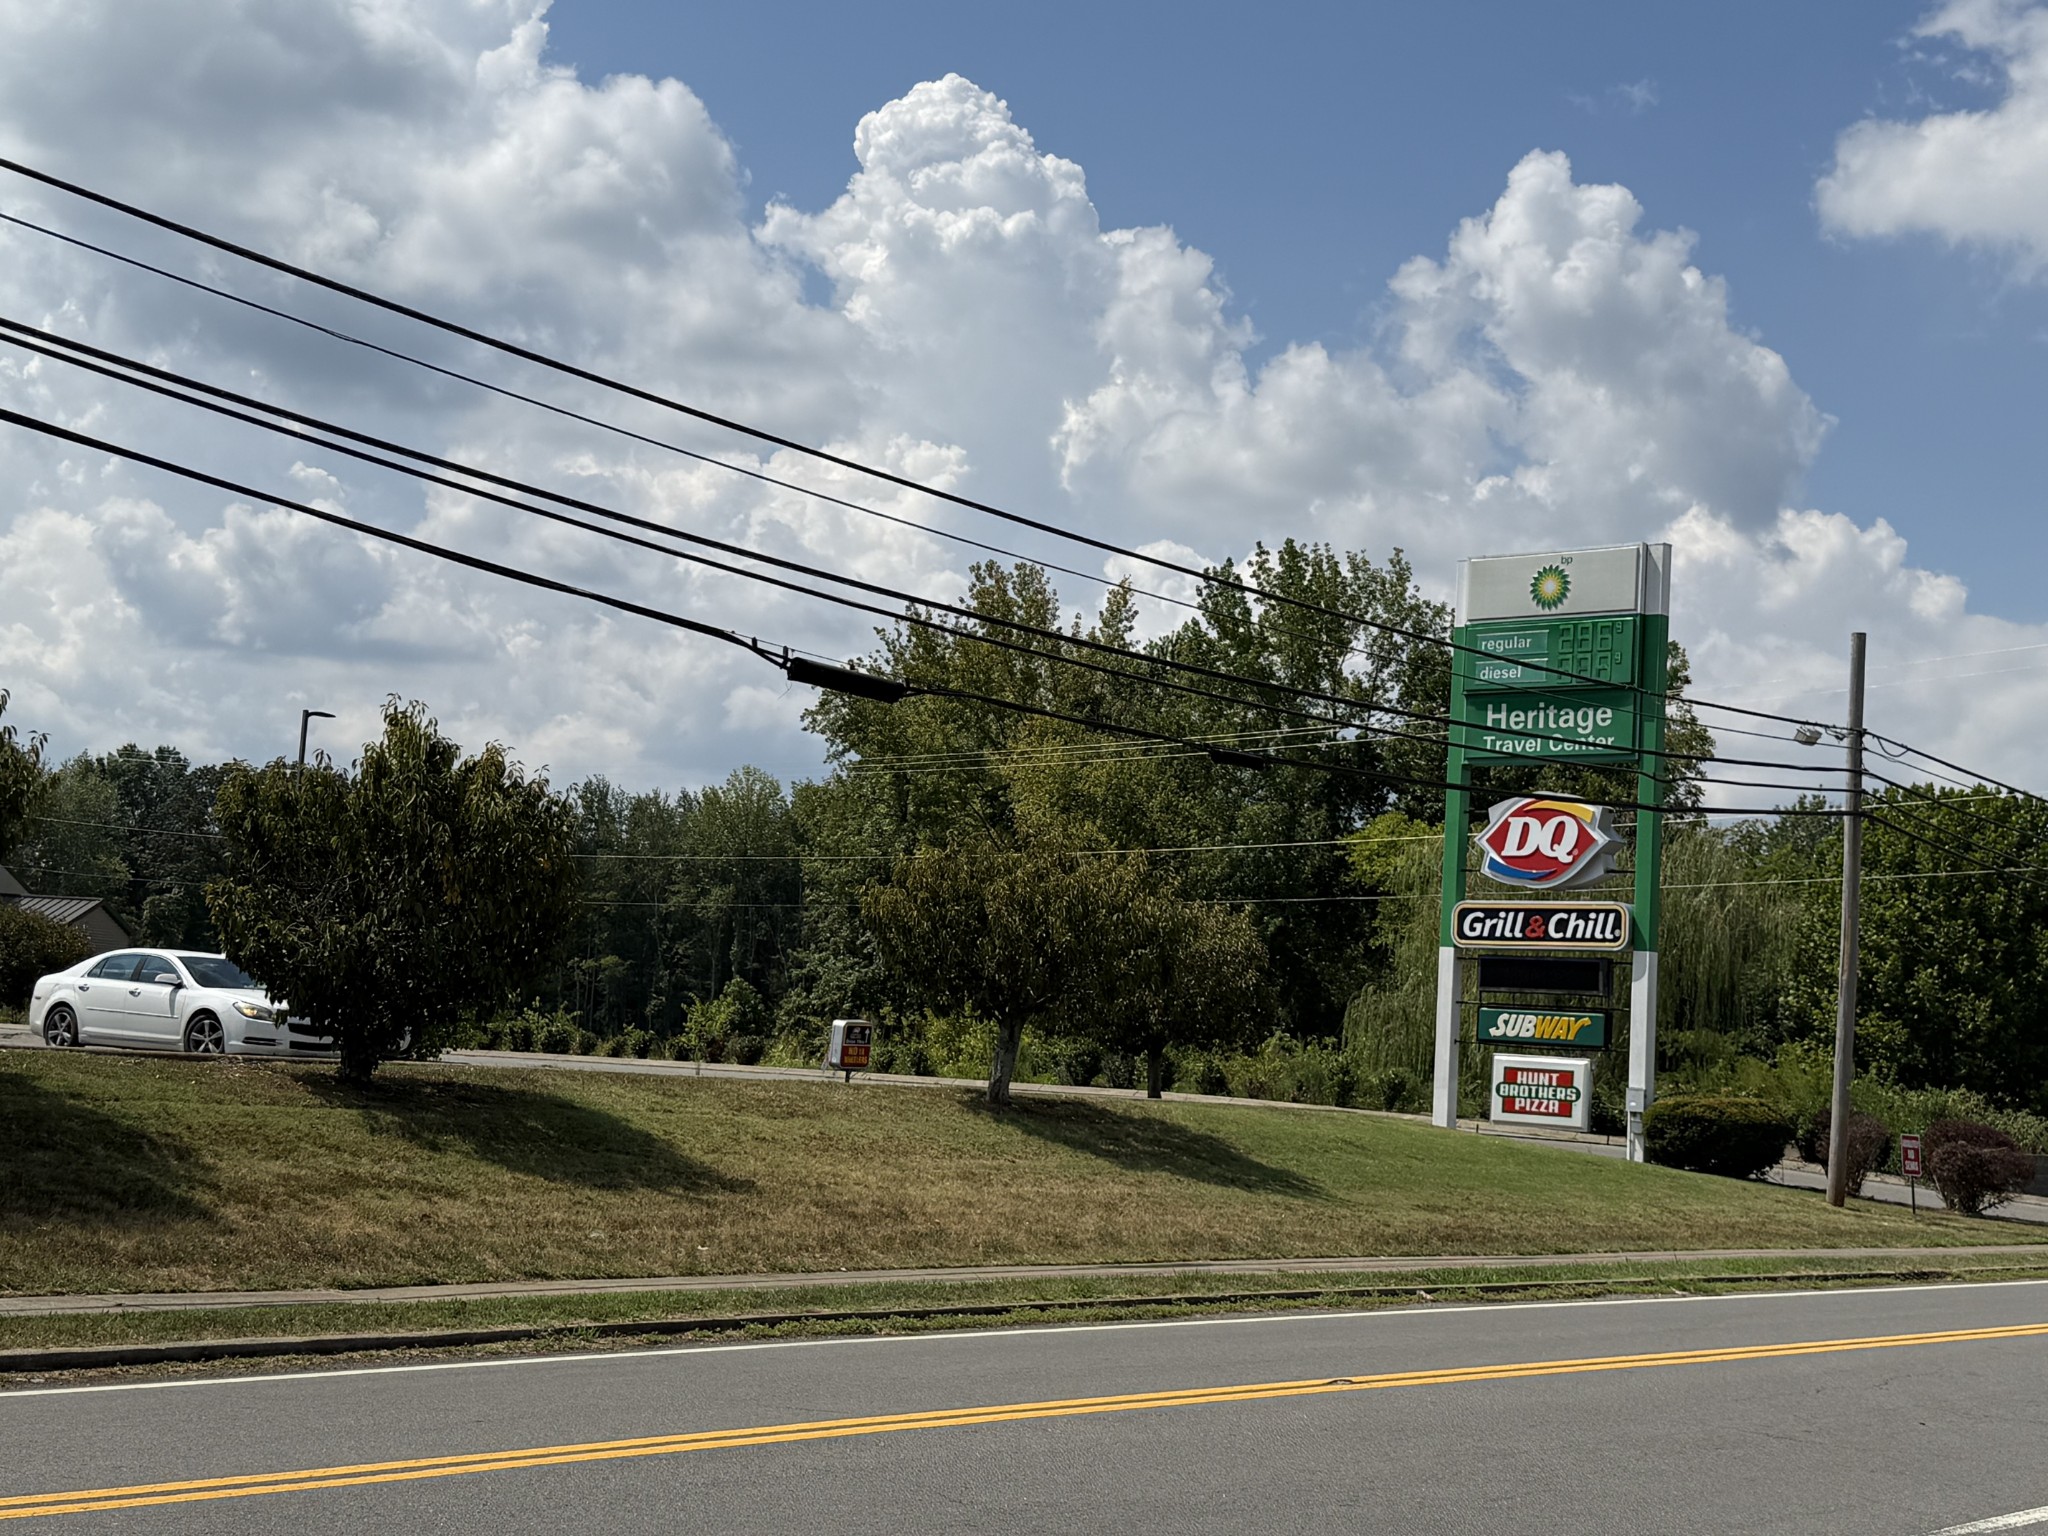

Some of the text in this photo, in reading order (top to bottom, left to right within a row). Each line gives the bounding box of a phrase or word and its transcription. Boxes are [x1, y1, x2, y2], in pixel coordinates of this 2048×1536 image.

[1560, 555, 1573, 565] bp
[1481, 636, 1533, 652] regular
[1479, 665, 1522, 681] diesel
[1486, 701, 1613, 735] Heritage
[1483, 735, 1541, 753] Travel
[1500, 814, 1580, 864] DQ
[1488, 1012, 1592, 1042] SUBWAY
[1516, 1071, 1560, 1086] HUNT
[1499, 1084, 1577, 1101] BROTHERS
[1514, 1098, 1560, 1114] PIZZA
